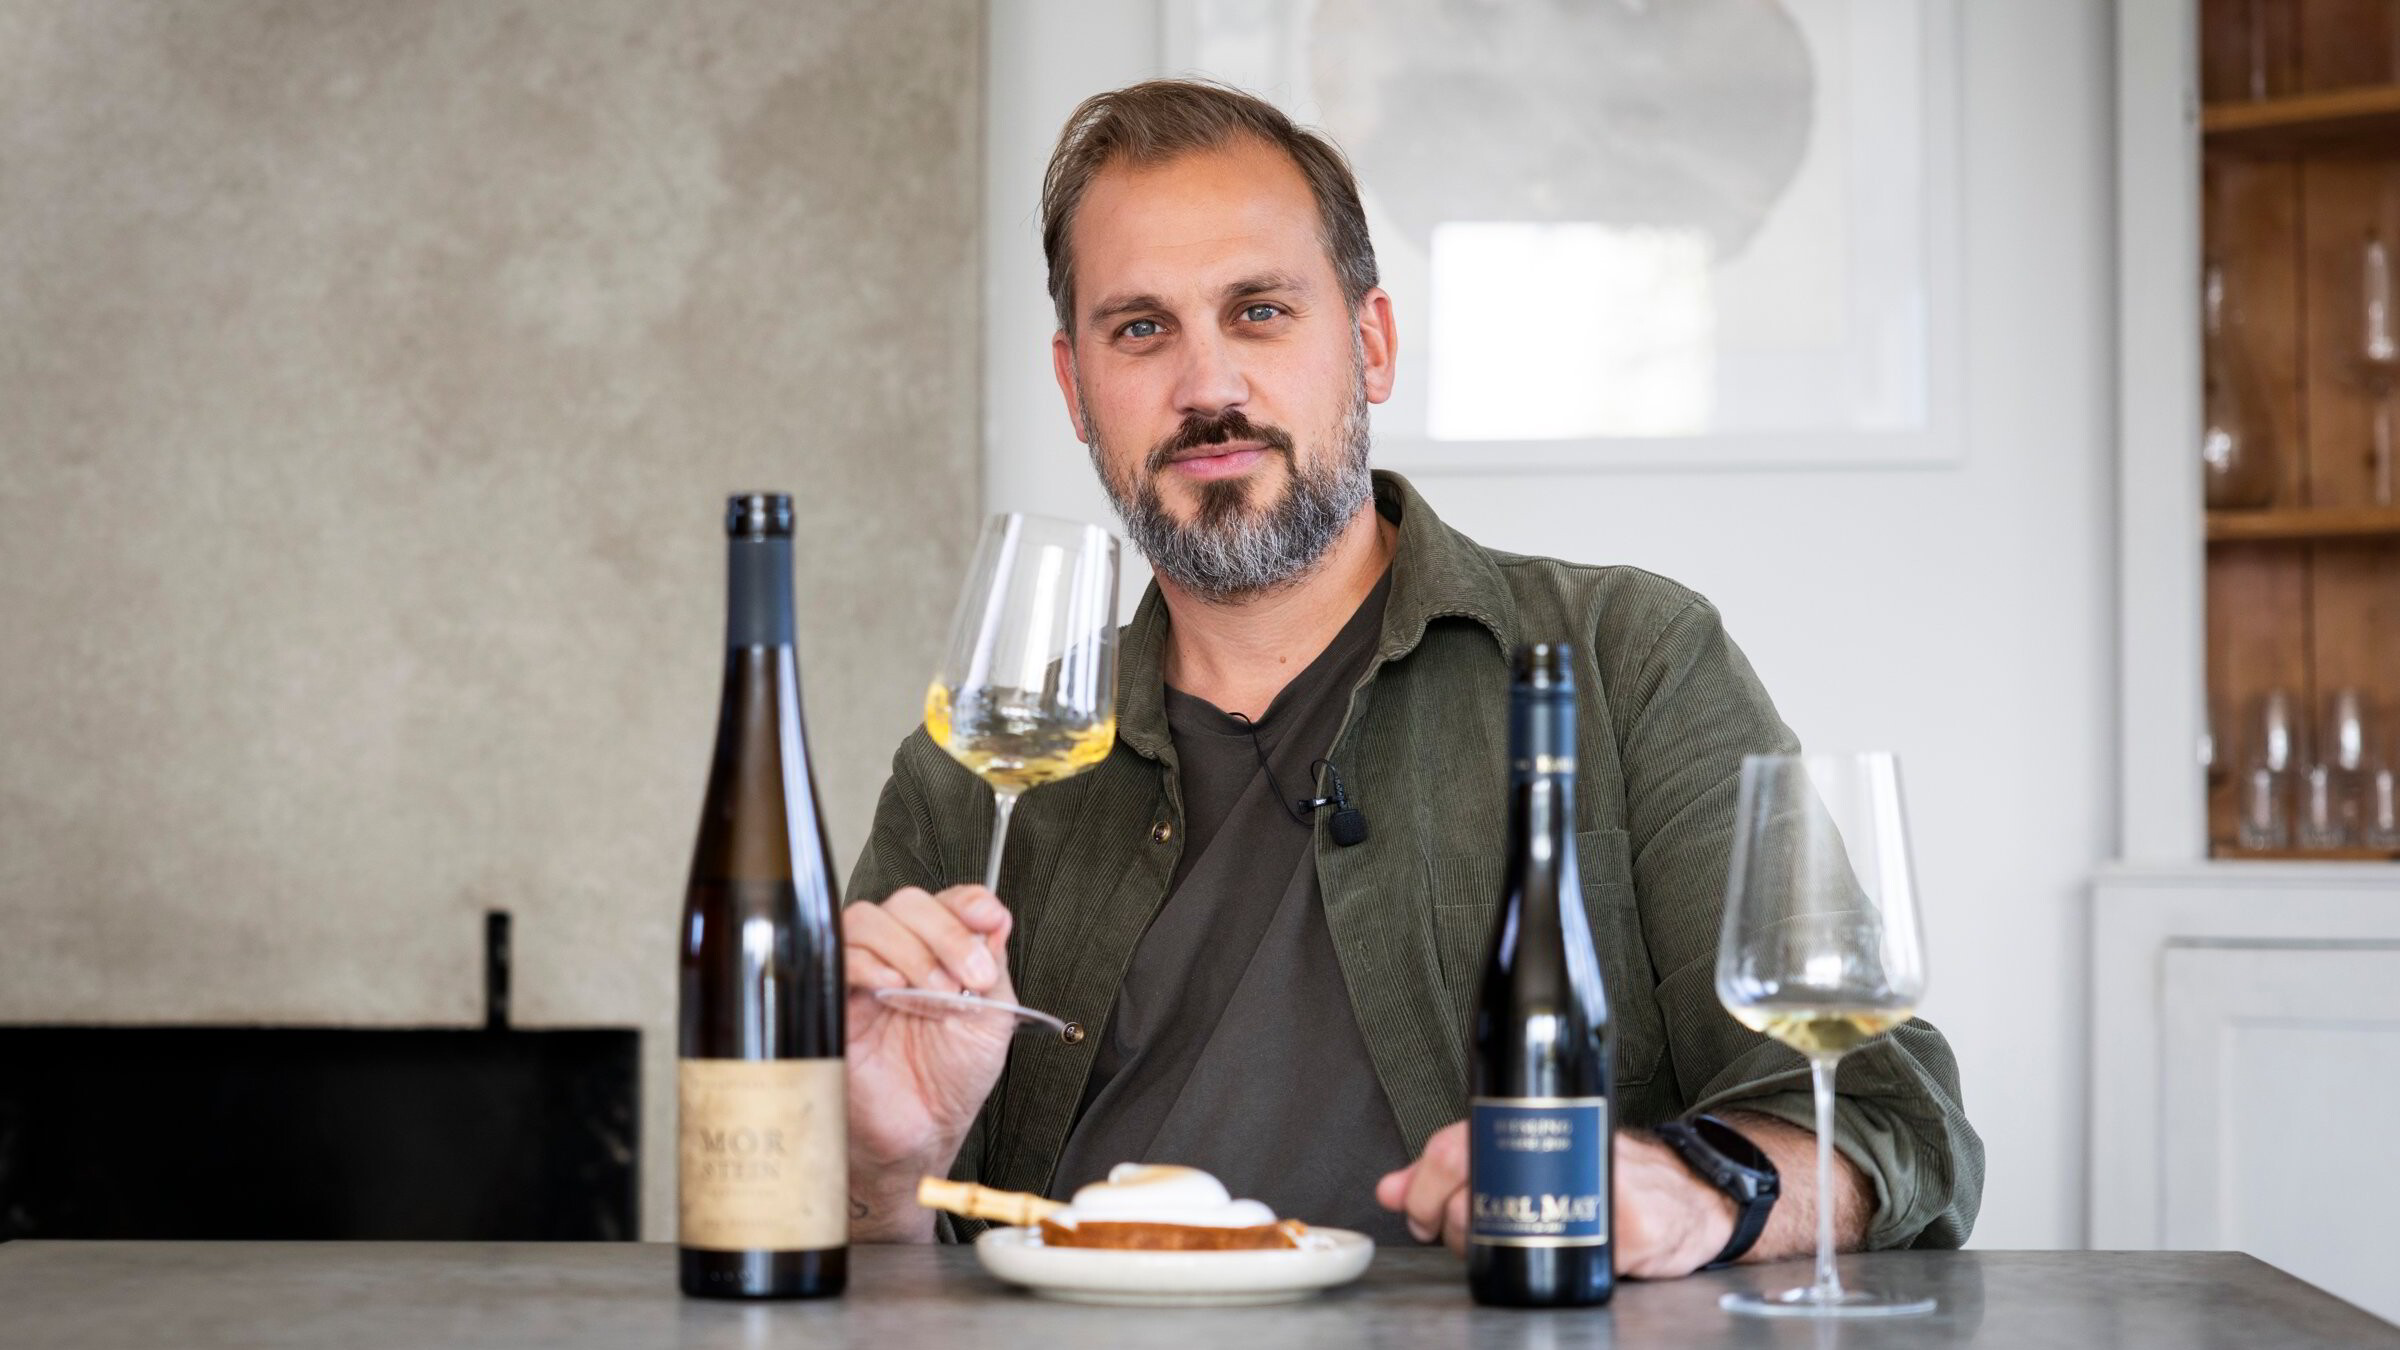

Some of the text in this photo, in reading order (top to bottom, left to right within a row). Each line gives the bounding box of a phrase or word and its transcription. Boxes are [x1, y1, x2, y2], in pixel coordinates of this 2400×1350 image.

[699, 1126, 787, 1155] MOR
[700, 1160, 781, 1180] STEIN
[1473, 1193, 1600, 1222] KARL MAY
